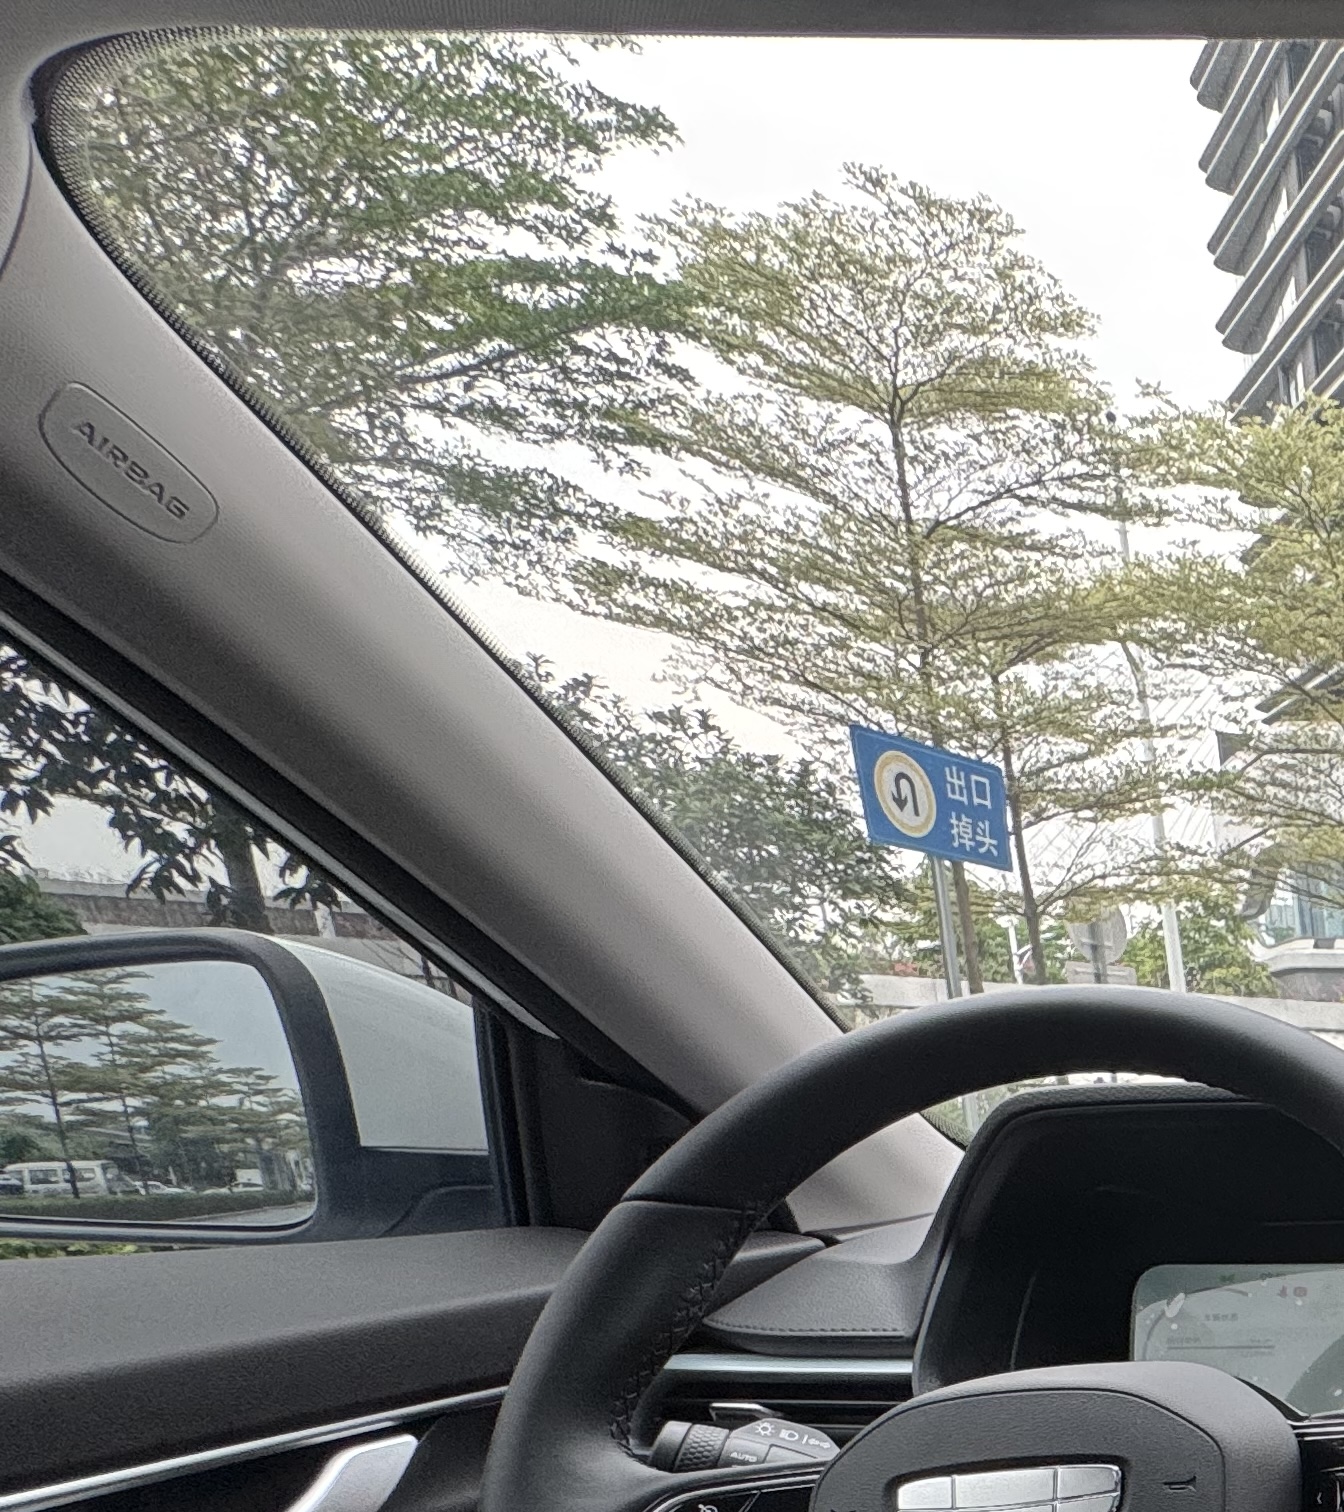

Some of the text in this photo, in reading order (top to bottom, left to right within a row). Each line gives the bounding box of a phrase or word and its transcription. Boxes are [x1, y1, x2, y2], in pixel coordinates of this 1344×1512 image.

[71, 420, 191, 520] AIRBAG
[944, 765, 992, 810] 出口
[949, 811, 999, 857] 掉头
[729, 1451, 758, 1463] AUTO
